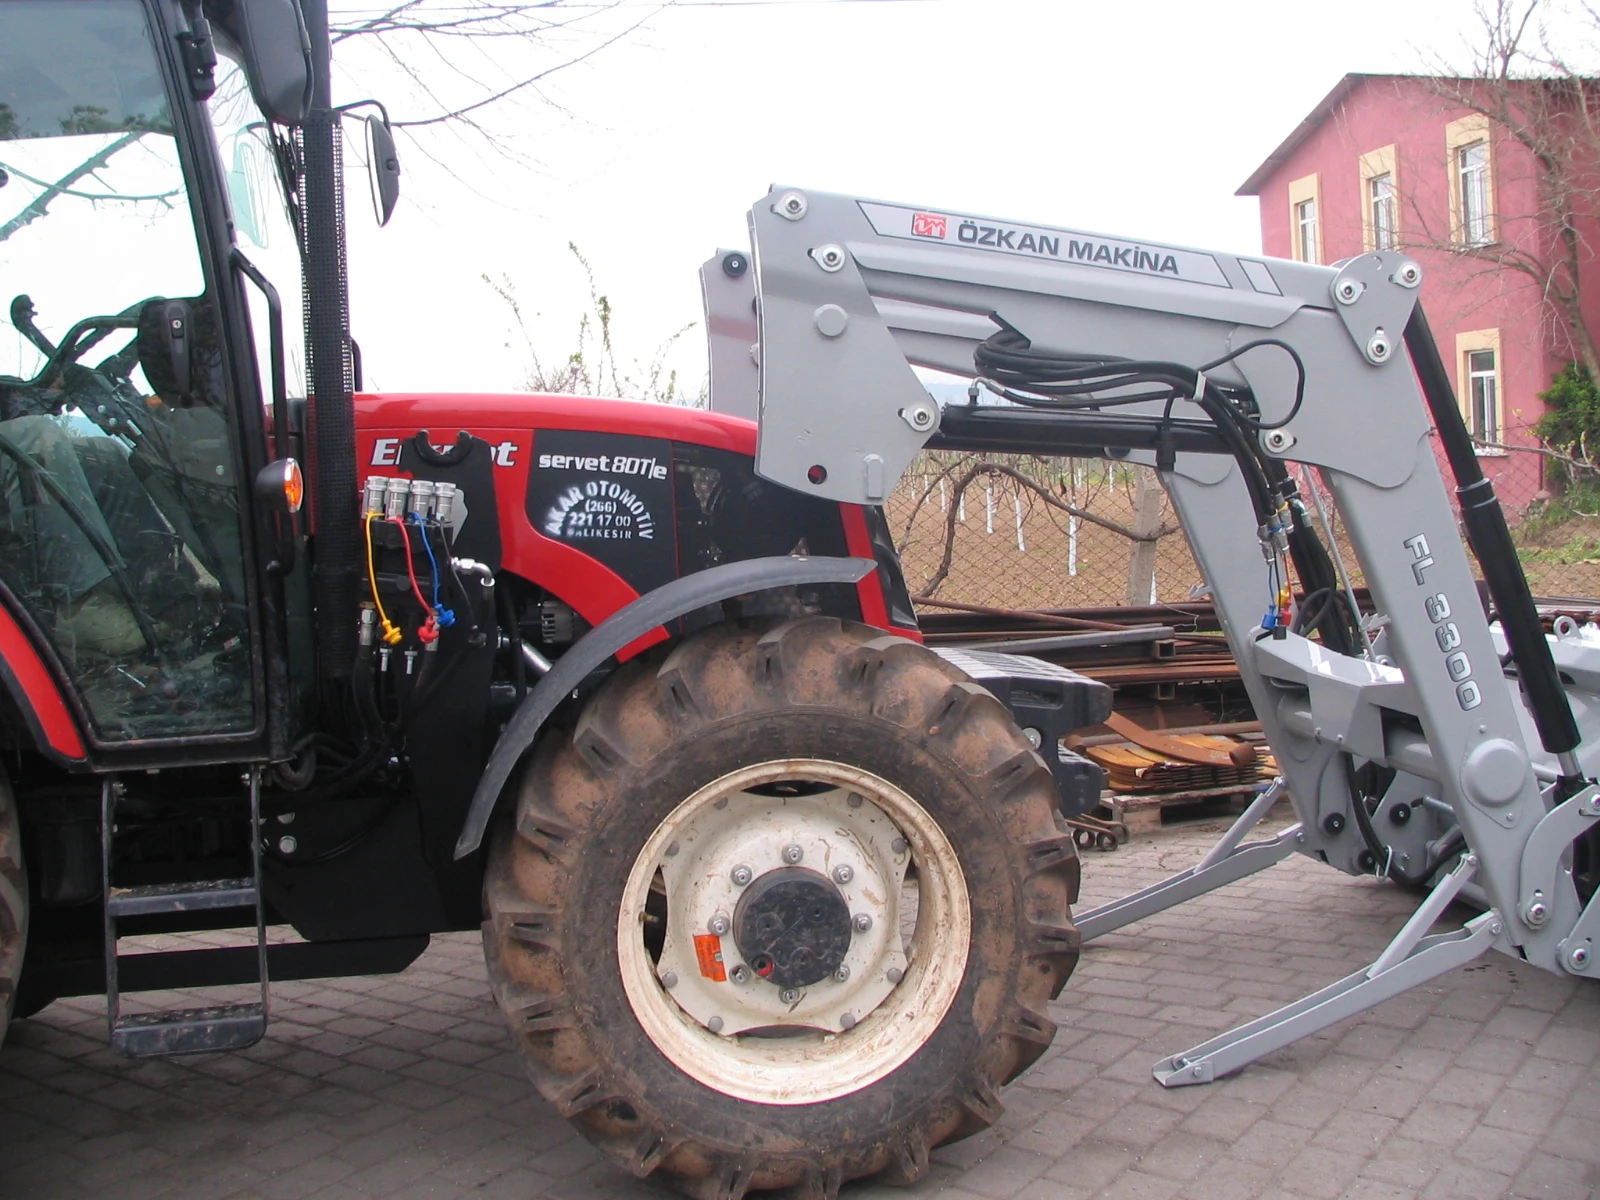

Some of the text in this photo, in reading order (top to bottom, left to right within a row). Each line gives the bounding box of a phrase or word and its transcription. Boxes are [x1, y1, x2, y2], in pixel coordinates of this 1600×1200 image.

[957, 220, 1060, 256] ÖZKAN
[1067, 239, 1180, 275] MAKİNA
[539, 454, 610, 472] servet
[544, 486, 585, 536] AKAR
[569, 511, 631, 527] 221 17 00
[585, 499, 617, 514] (266)
[1403, 532, 1482, 711] FL 3300
